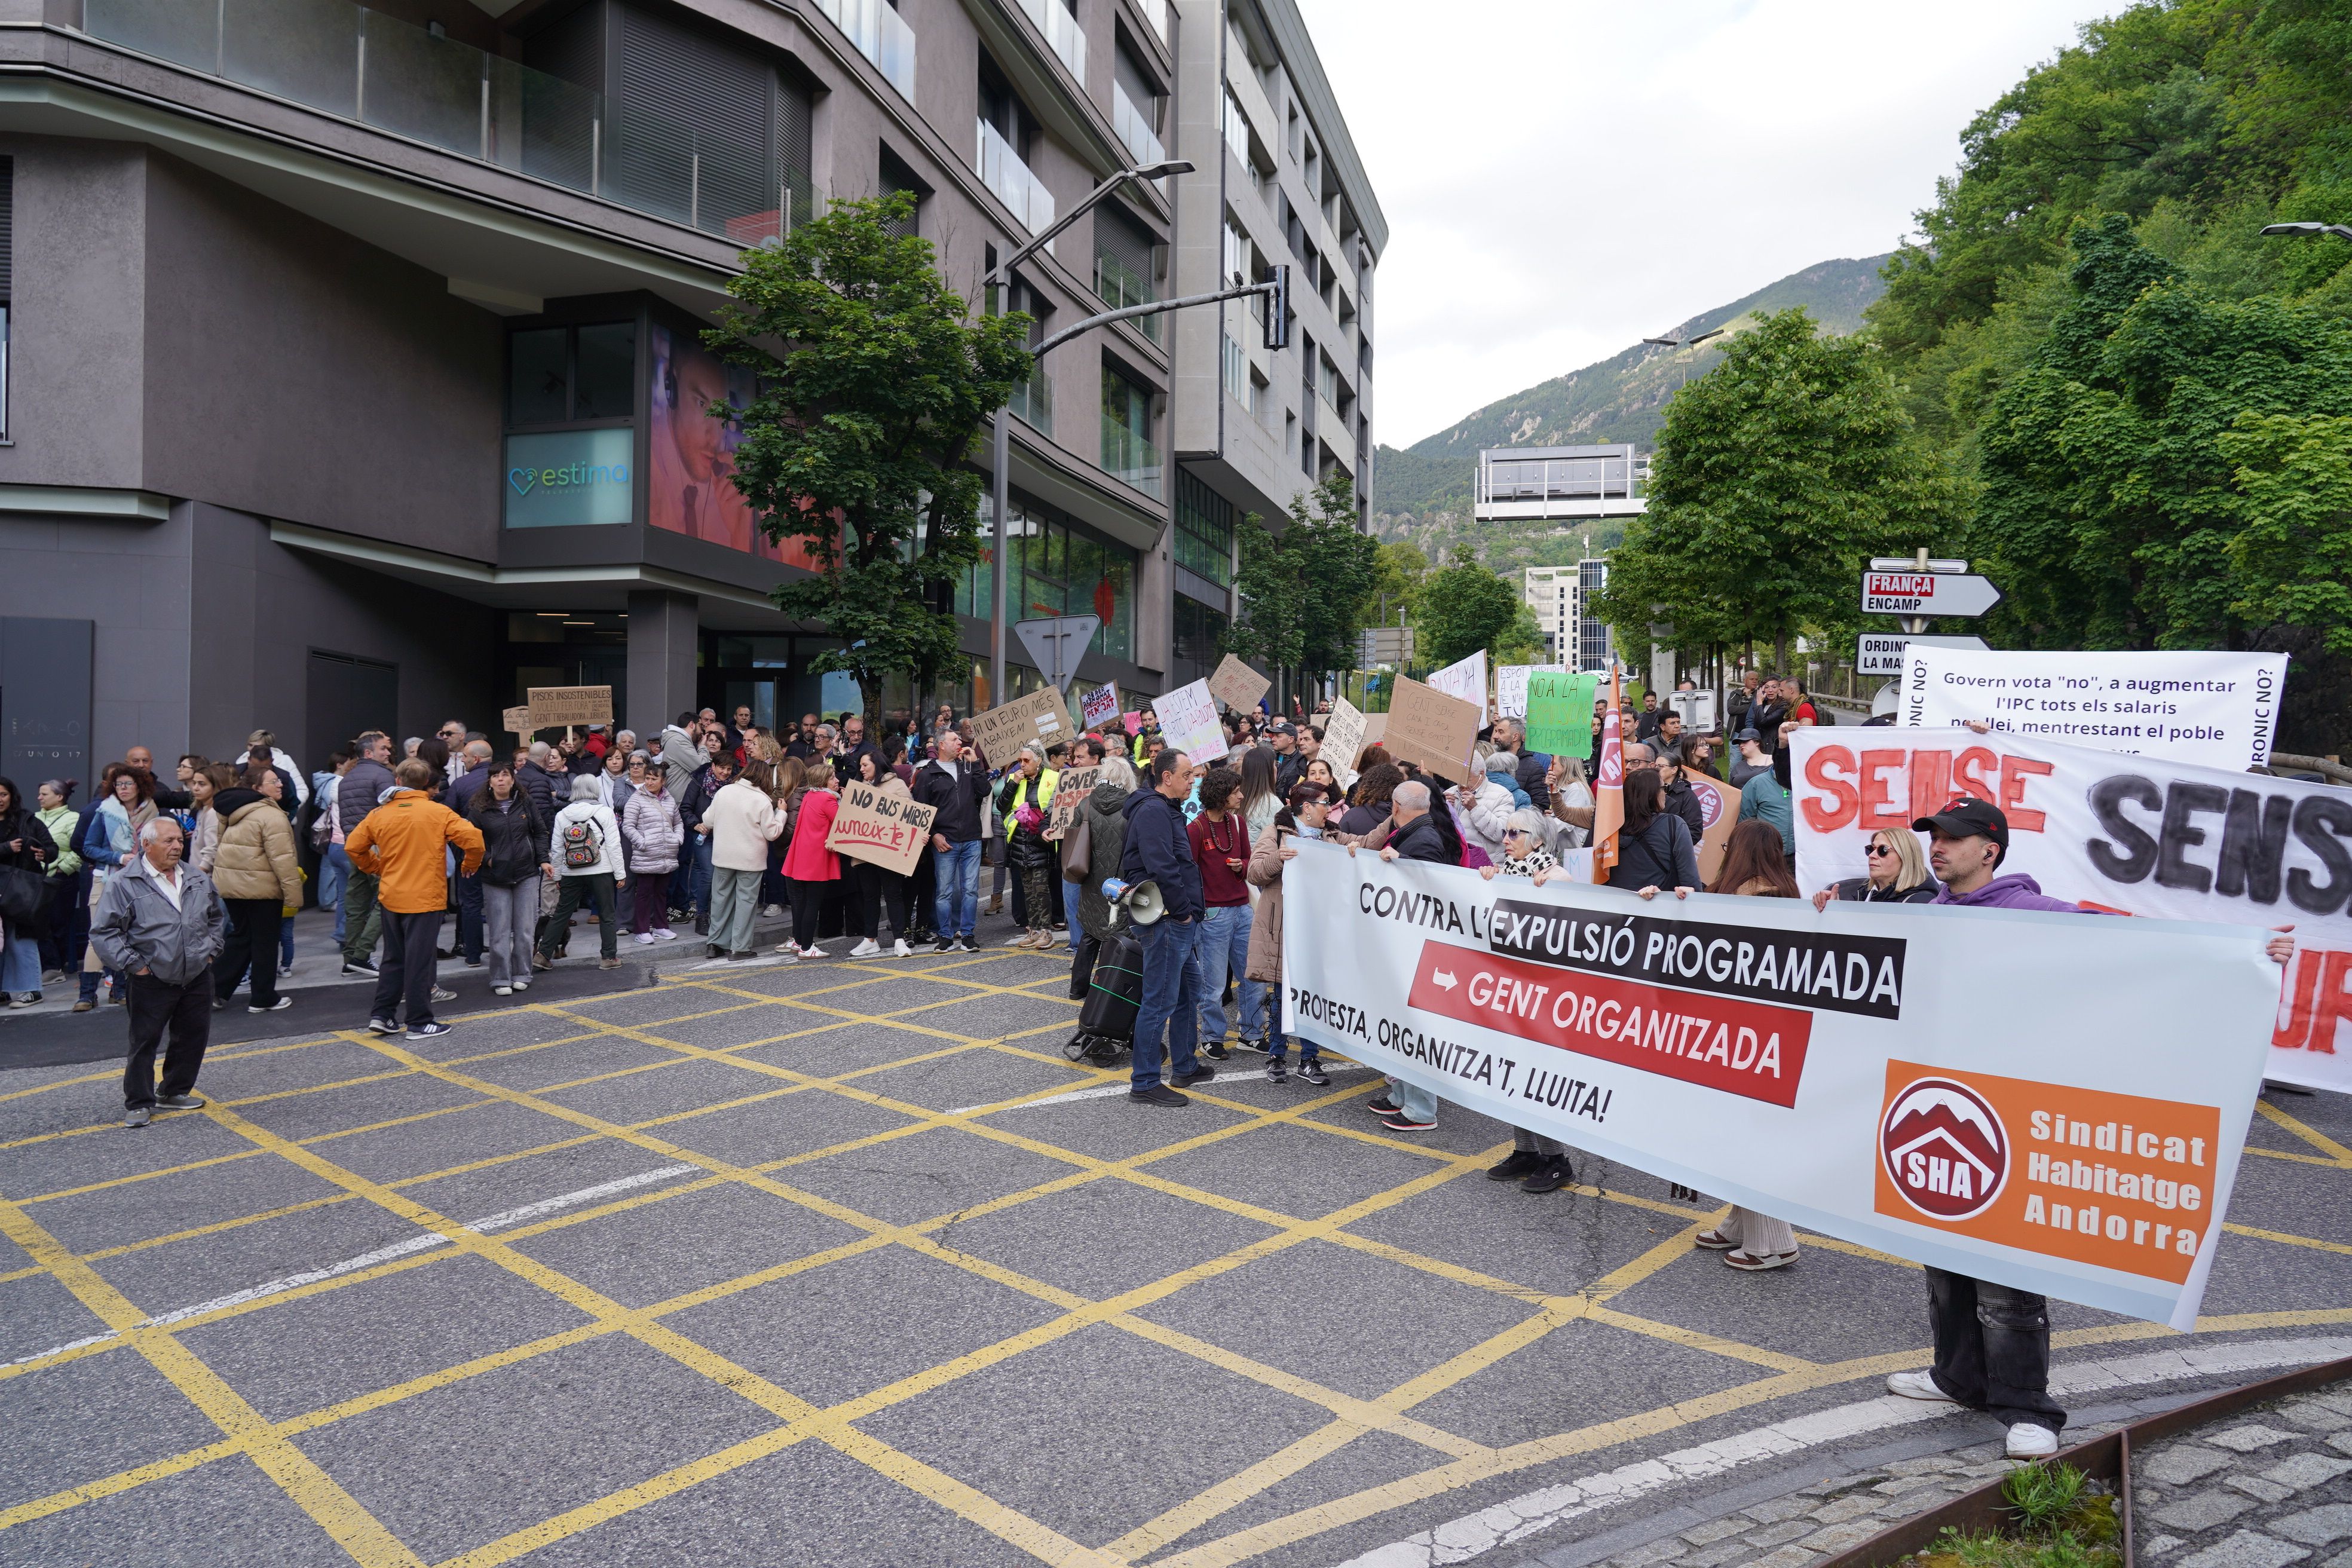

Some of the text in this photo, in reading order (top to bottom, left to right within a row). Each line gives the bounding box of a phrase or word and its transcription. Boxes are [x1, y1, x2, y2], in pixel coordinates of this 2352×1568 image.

[542, 461, 627, 486] estima
[1871, 576, 1932, 596] FRANÇA
[1868, 598, 1921, 610] ENCAMP
[1500, 667, 1526, 678] ESPOT
[1864, 657, 1903, 669] LA MA
[1464, 662, 1474, 691] YA
[1913, 659, 1927, 691] NO?
[1944, 672, 2006, 688] Govern
[2012, 675, 2051, 688] vota
[2109, 679, 2120, 690] a
[2126, 679, 2236, 694] augmentar
[2256, 669, 2273, 703] NO?
[532, 690, 611, 701] PISOS INSOSTENIBLES
[1088, 687, 1104, 700] OBRER
[1500, 680, 1520, 693] A LA
[1530, 678, 1579, 700] NO A LA
[538, 702, 558, 712] VOLEU
[561, 702, 574, 711] FER
[575, 701, 589, 710] FORA
[1168, 687, 1198, 715] ESTEM
[1407, 693, 1434, 713] GENT
[1499, 694, 1508, 705] TE
[2041, 699, 2076, 712] tots
[2082, 699, 2108, 712] els
[2114, 700, 2177, 715] salaris
[535, 713, 551, 723] GENT
[973, 691, 1055, 737] NI UN EURO MÉS
[1529, 727, 1587, 748] PROGRAMADA
[2022, 720, 2140, 737] mentrestant
[2147, 724, 2163, 737] el
[2170, 726, 2225, 742] poble
[989, 746, 1005, 764] ELS
[1059, 768, 1100, 793] GOVER
[1800, 745, 2054, 833] SENSE
[850, 789, 873, 808] NO
[875, 797, 901, 816] ENS
[1055, 789, 1092, 808] DESPE
[2085, 774, 2352, 917] SENS
[1360, 882, 1465, 935] CONTRA
[1643, 932, 1900, 1006] PROGRAMADA
[1468, 972, 1781, 1079] GENT ORGANITZADA
[1378, 1018, 1515, 1098] ORGANITZA'T,
[1523, 1067, 1612, 1123] LLUITA!
[2030, 1110, 2204, 1166] Sindicat
[1907, 1152, 1972, 1199] SHA
[2028, 1152, 2201, 1211] Habitatge
[2023, 1194, 2197, 1256] Andorra
